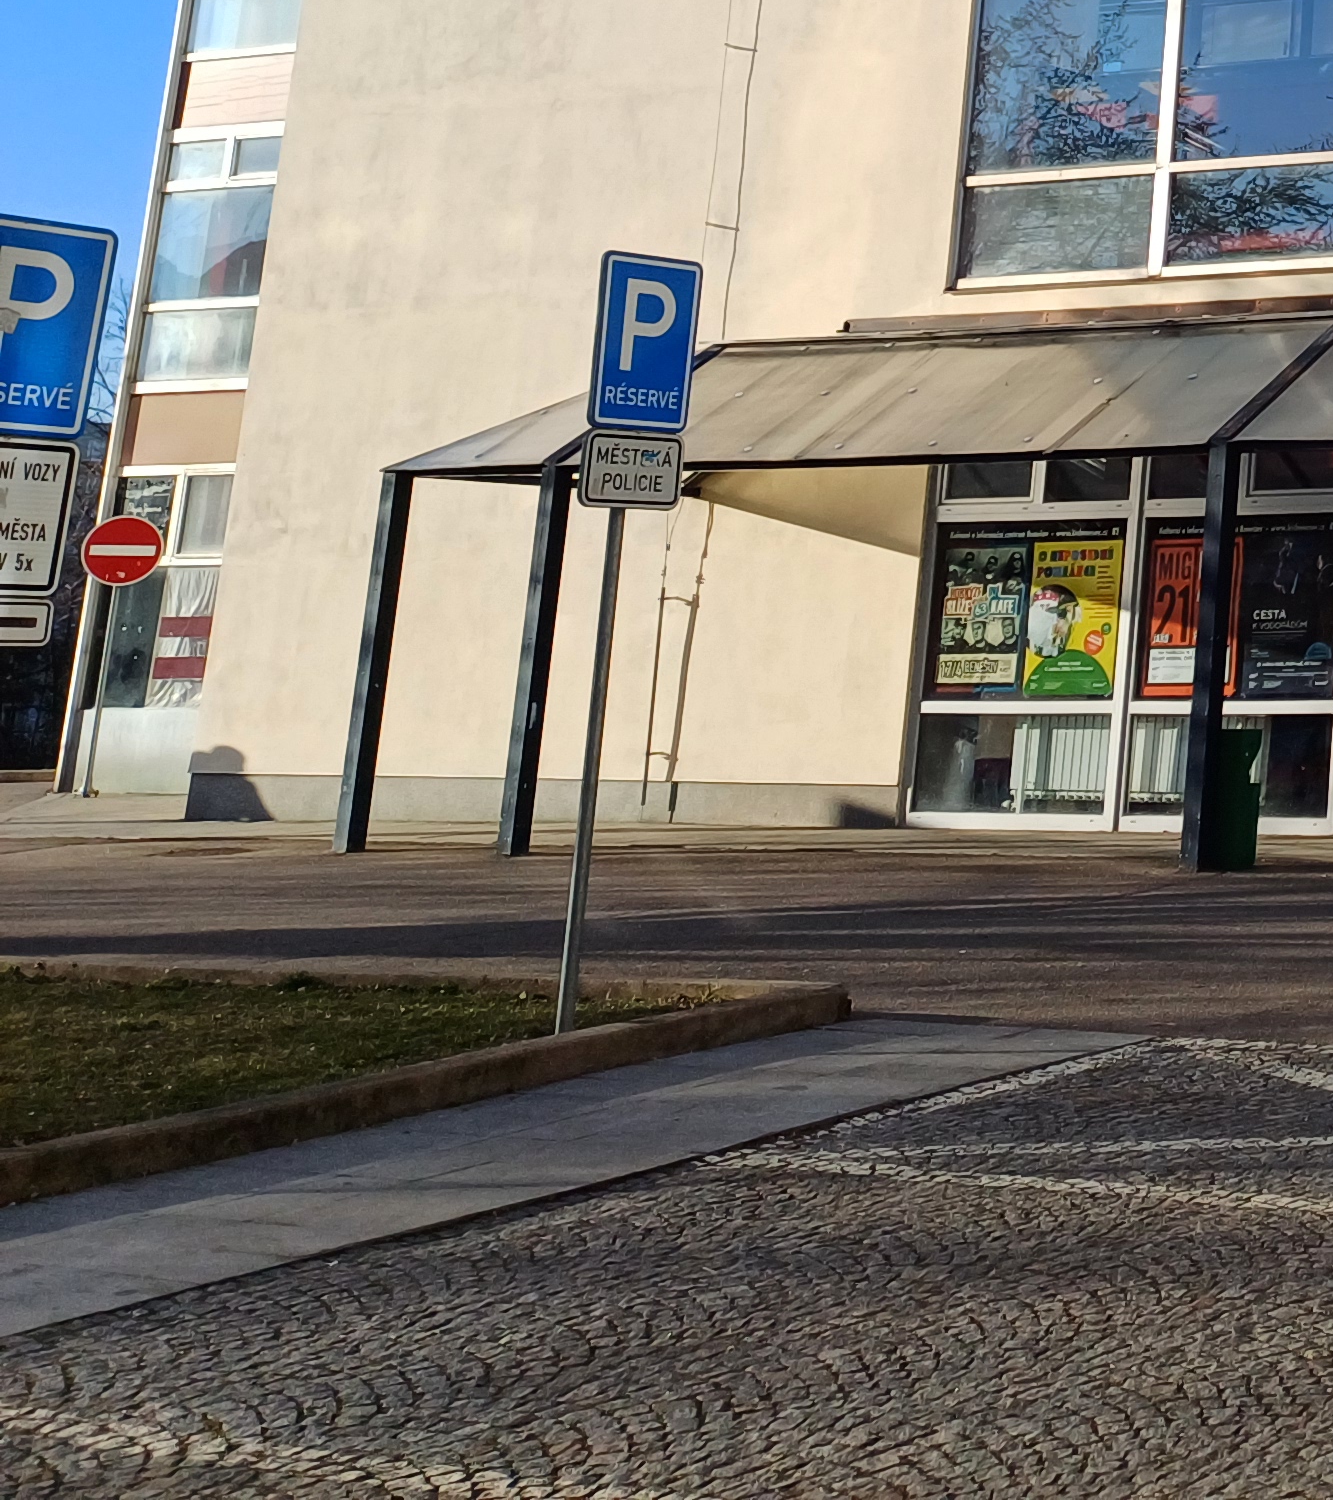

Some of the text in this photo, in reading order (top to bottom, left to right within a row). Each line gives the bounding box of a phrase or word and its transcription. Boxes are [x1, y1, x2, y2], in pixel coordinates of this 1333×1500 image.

[618, 277, 677, 372] P
[604, 382, 680, 409] RÉSERVÉ
[24, 461, 62, 482] VOZY
[601, 472, 664, 493] POLICIE
[15, 552, 35, 572] 5x
[1159, 550, 1193, 580] MIG
[1154, 584, 1191, 643] 21
[1252, 609, 1287, 620] CESTA
